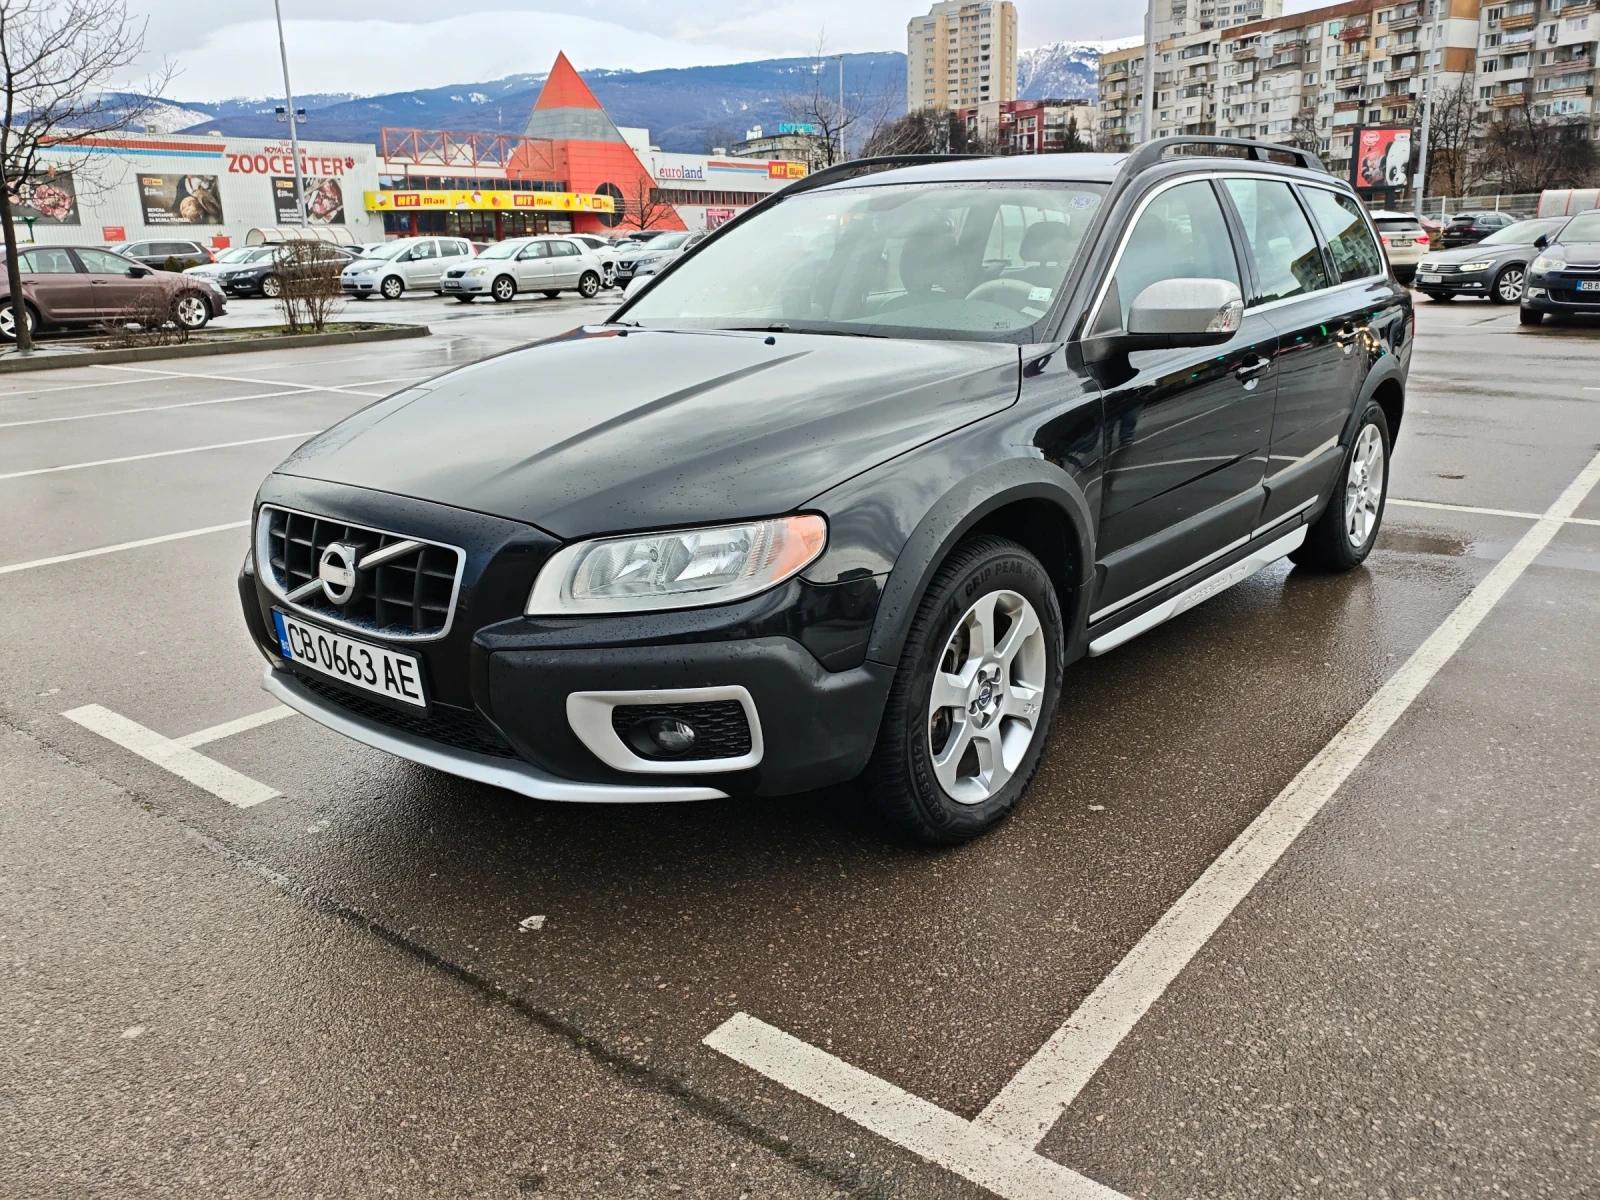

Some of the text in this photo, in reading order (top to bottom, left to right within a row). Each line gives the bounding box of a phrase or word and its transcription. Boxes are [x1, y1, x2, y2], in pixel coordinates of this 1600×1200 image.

[264, 146, 284, 154] ROYAL
[226, 154, 345, 176] ZOOCENTER
[771, 165, 785, 175] HIT
[659, 165, 703, 179] euroland
[397, 196, 417, 206] HIT
[515, 196, 532, 206] HIT
[965, 567, 991, 598] GRIP
[994, 560, 1023, 575] PEAK
[287, 622, 419, 700] CB 0663 AE
